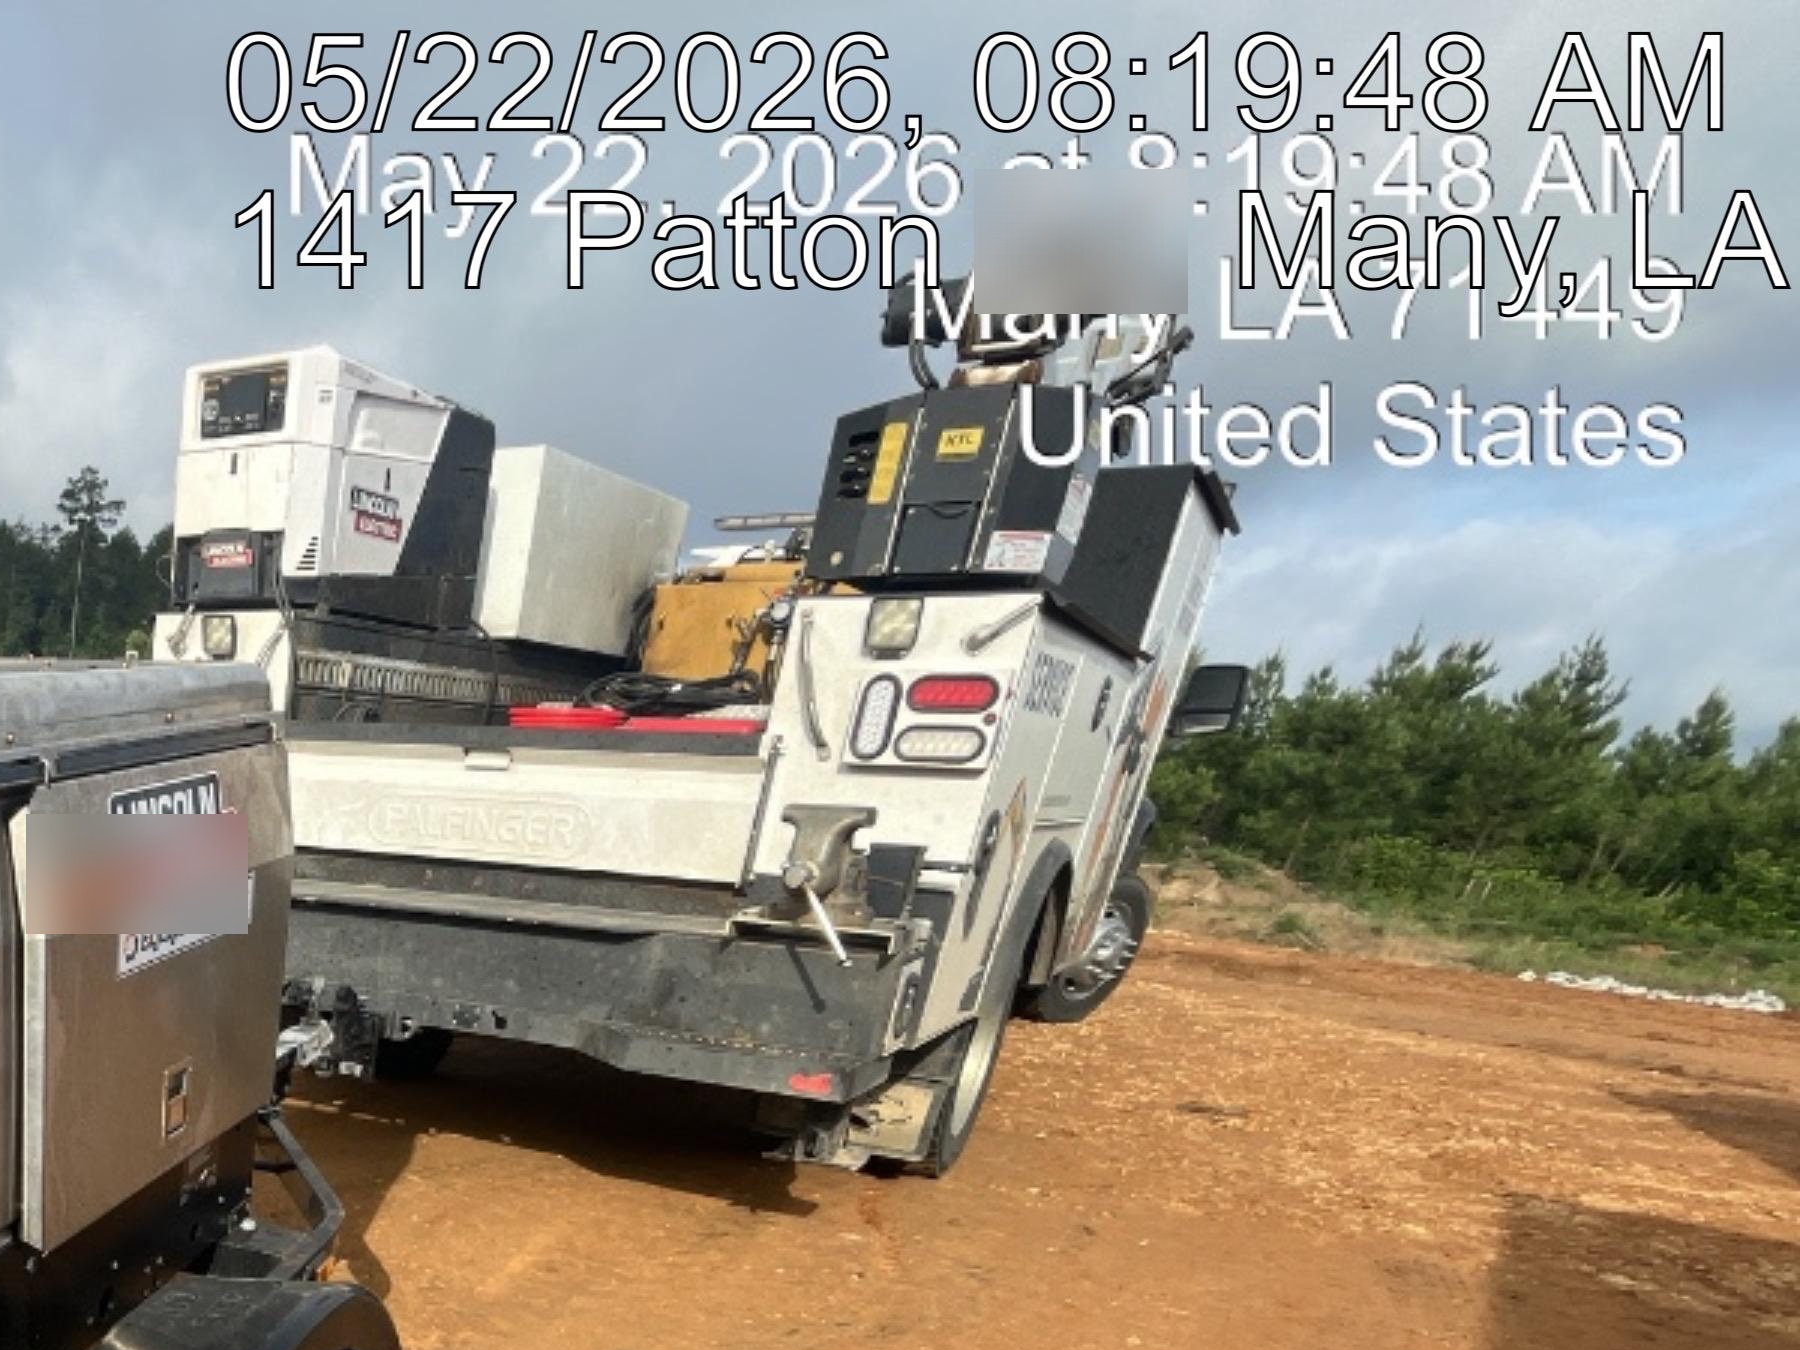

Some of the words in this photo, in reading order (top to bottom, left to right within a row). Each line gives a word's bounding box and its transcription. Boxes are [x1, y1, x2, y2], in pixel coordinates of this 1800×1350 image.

[352, 488, 399, 518] LINCOLN
[116, 783, 217, 814] COLN
[385, 803, 575, 850] PALFINGER
